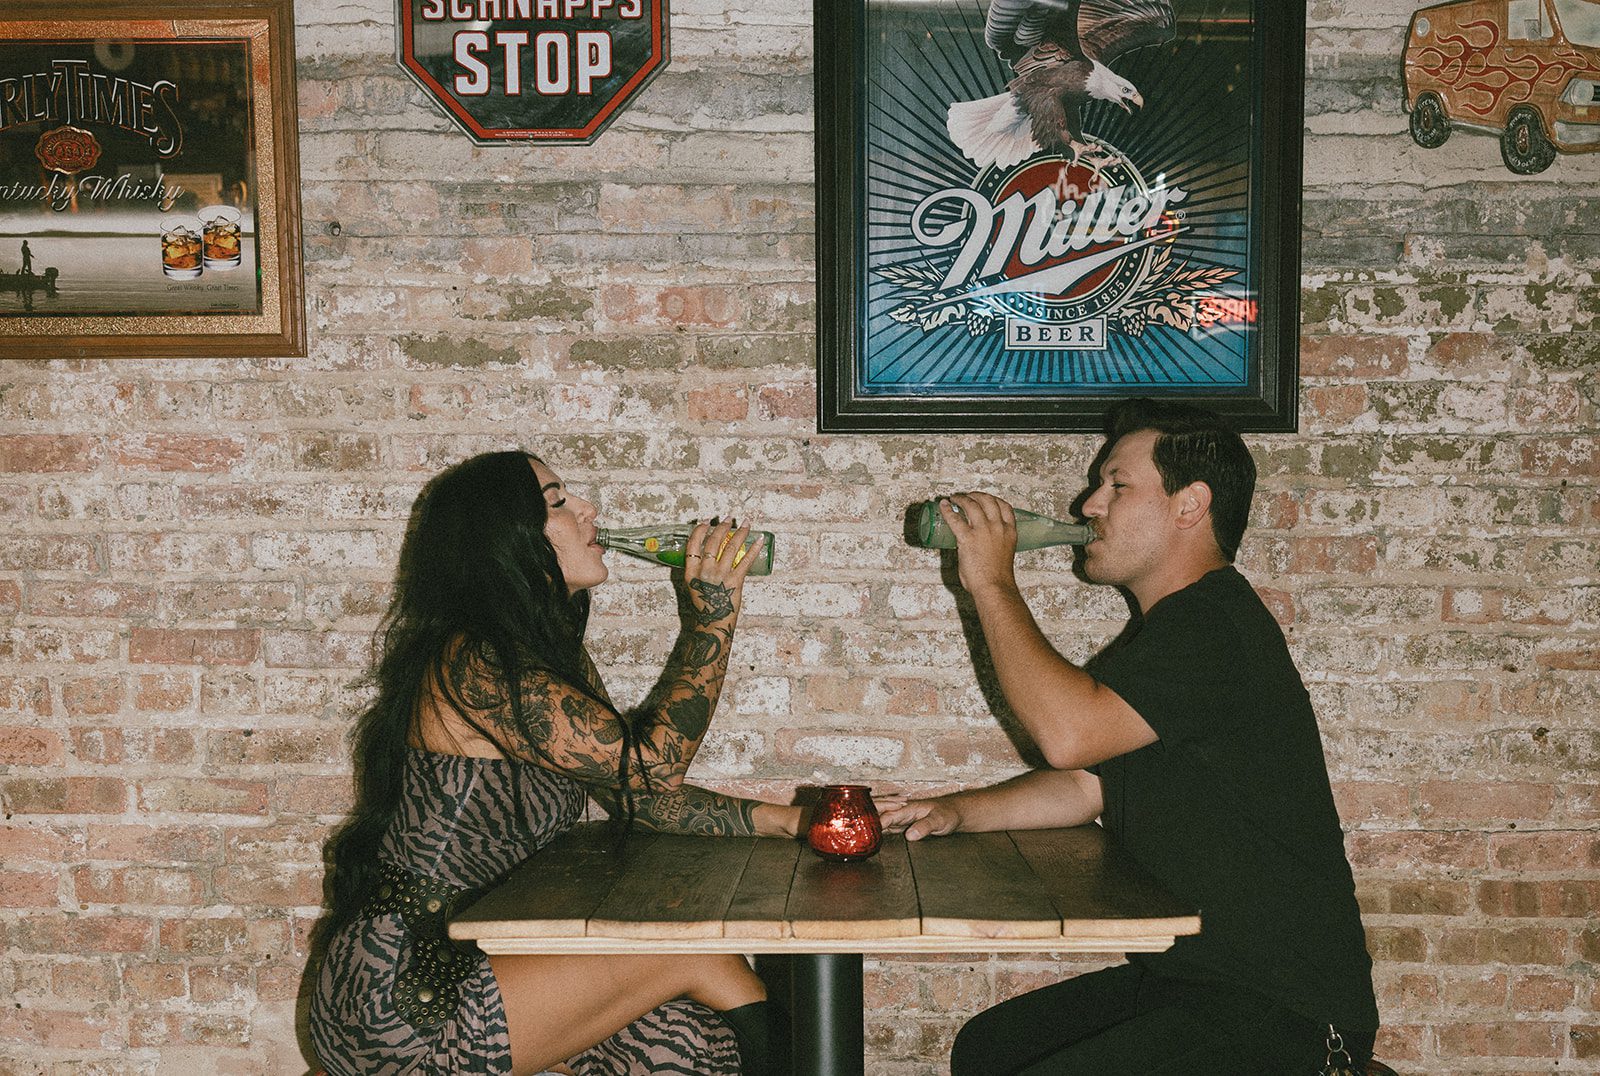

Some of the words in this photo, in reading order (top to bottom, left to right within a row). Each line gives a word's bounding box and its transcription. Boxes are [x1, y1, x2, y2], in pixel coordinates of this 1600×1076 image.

[455, 32, 612, 95] STOP
[52, 60, 183, 160] TIMES
[79, 173, 186, 212] Whisky
[911, 186, 1189, 291] Miller
[1035, 305, 1088, 319] SINCE
[1093, 279, 1125, 309] 1855
[1015, 325, 1095, 342] BEER
